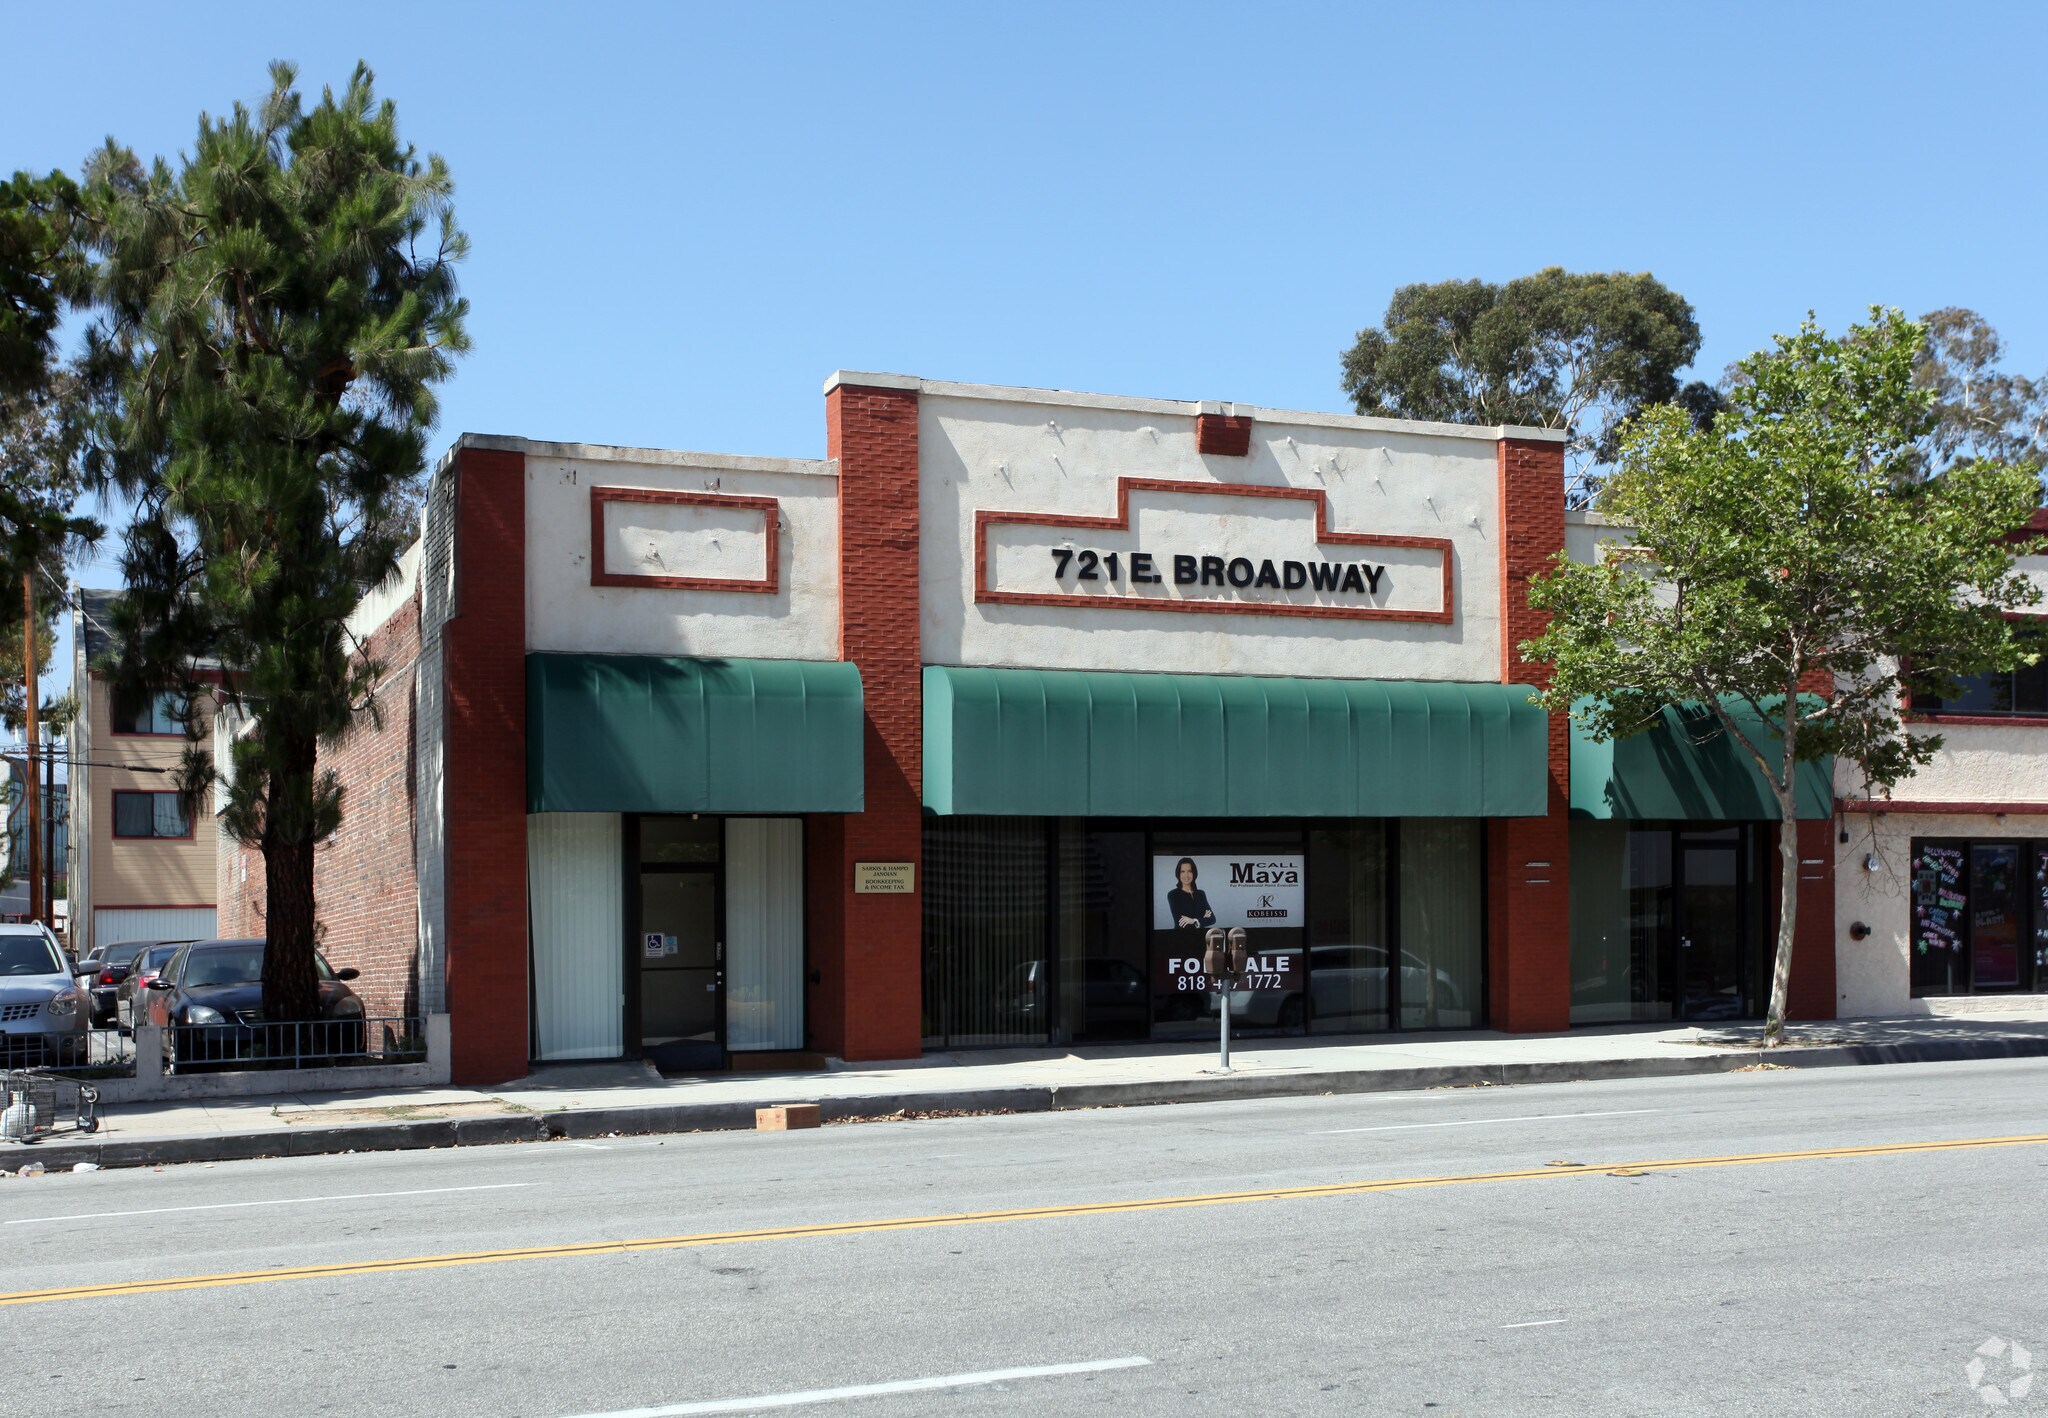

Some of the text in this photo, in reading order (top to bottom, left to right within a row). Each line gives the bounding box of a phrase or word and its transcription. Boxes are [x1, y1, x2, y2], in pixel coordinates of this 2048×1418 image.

[1052, 549, 1385, 594] 721 E. BROADWAY
[1230, 863, 1298, 884] Maya
[1168, 957, 1206, 974] FO
[1178, 975, 1206, 990] 818
[1246, 974, 1282, 989] 1772
